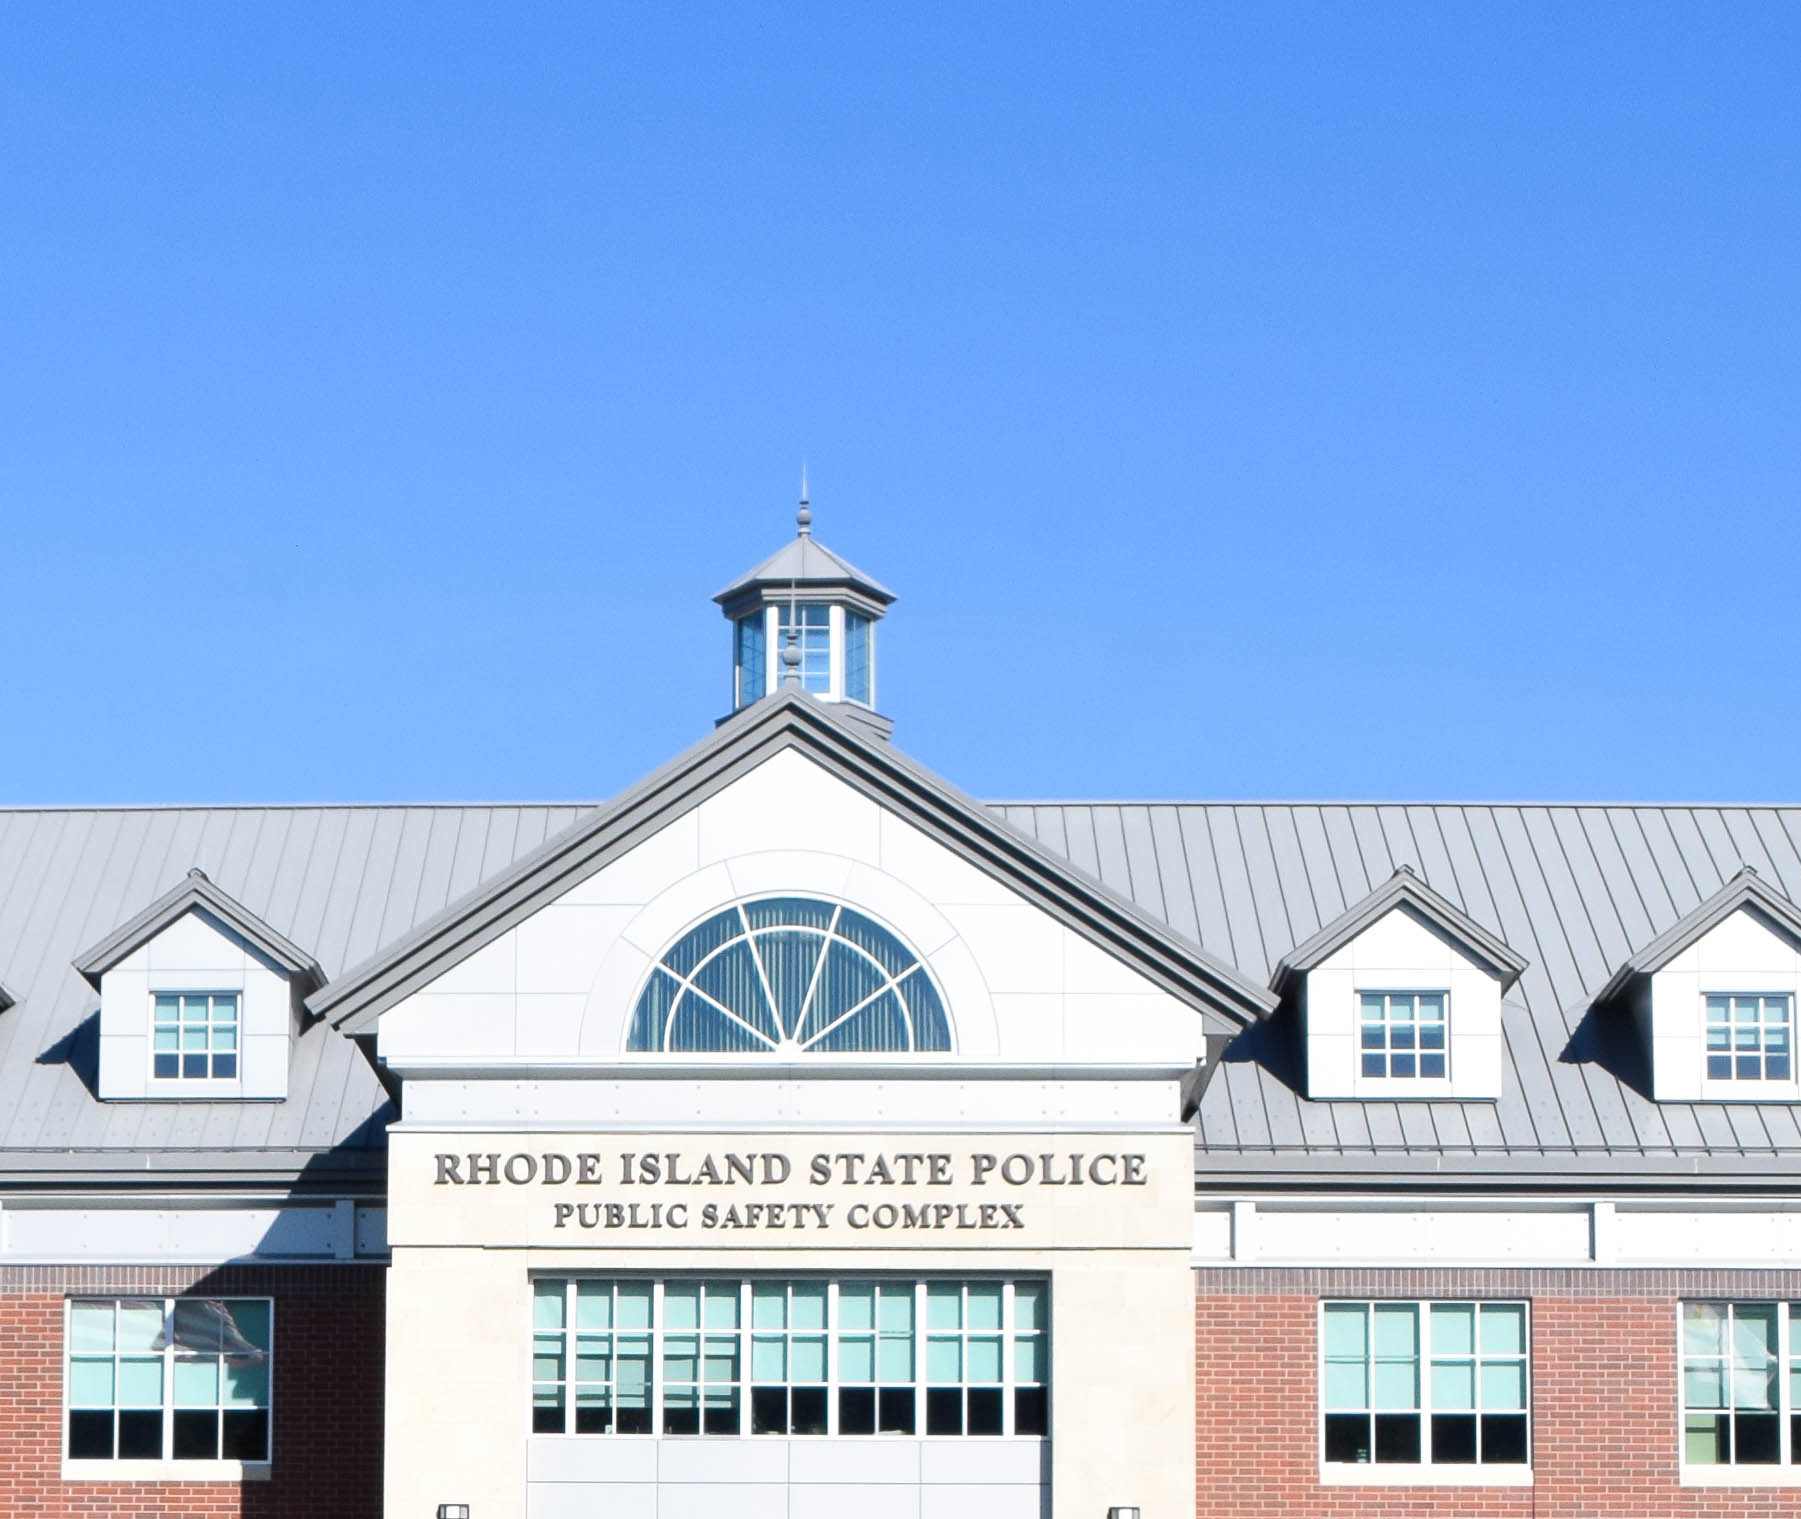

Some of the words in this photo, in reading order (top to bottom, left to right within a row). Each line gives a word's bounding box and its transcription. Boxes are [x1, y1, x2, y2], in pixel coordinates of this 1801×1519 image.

[434, 1153, 602, 1186] RHODE
[620, 1153, 791, 1186] ISLAND
[810, 1153, 951, 1186] STATE
[971, 1153, 1148, 1186] POLICE
[554, 1203, 687, 1230] PUBLIC
[702, 1203, 835, 1230] SAFETY
[847, 1203, 1025, 1230] COMPLEX
